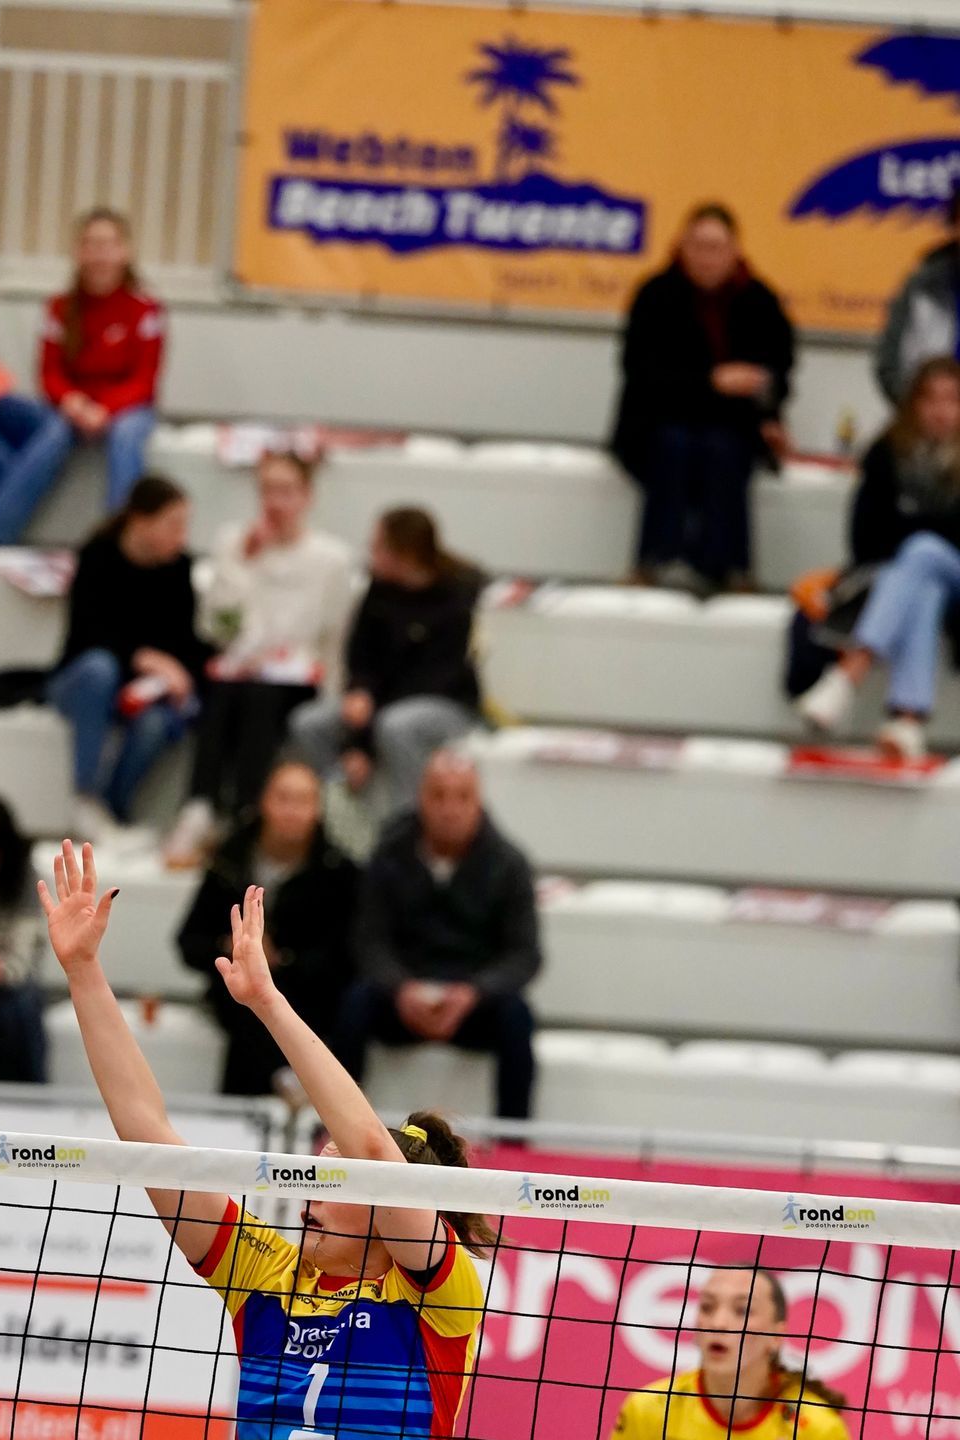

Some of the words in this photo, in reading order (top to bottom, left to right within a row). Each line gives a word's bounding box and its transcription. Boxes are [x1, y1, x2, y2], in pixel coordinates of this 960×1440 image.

[277, 179, 439, 237] Beach
[443, 190, 638, 250] Twente
[12, 1144, 85, 1161] rondom
[272, 1165, 347, 1181] rondom
[534, 1185, 610, 1202] rondom
[799, 1205, 876, 1221] rondom
